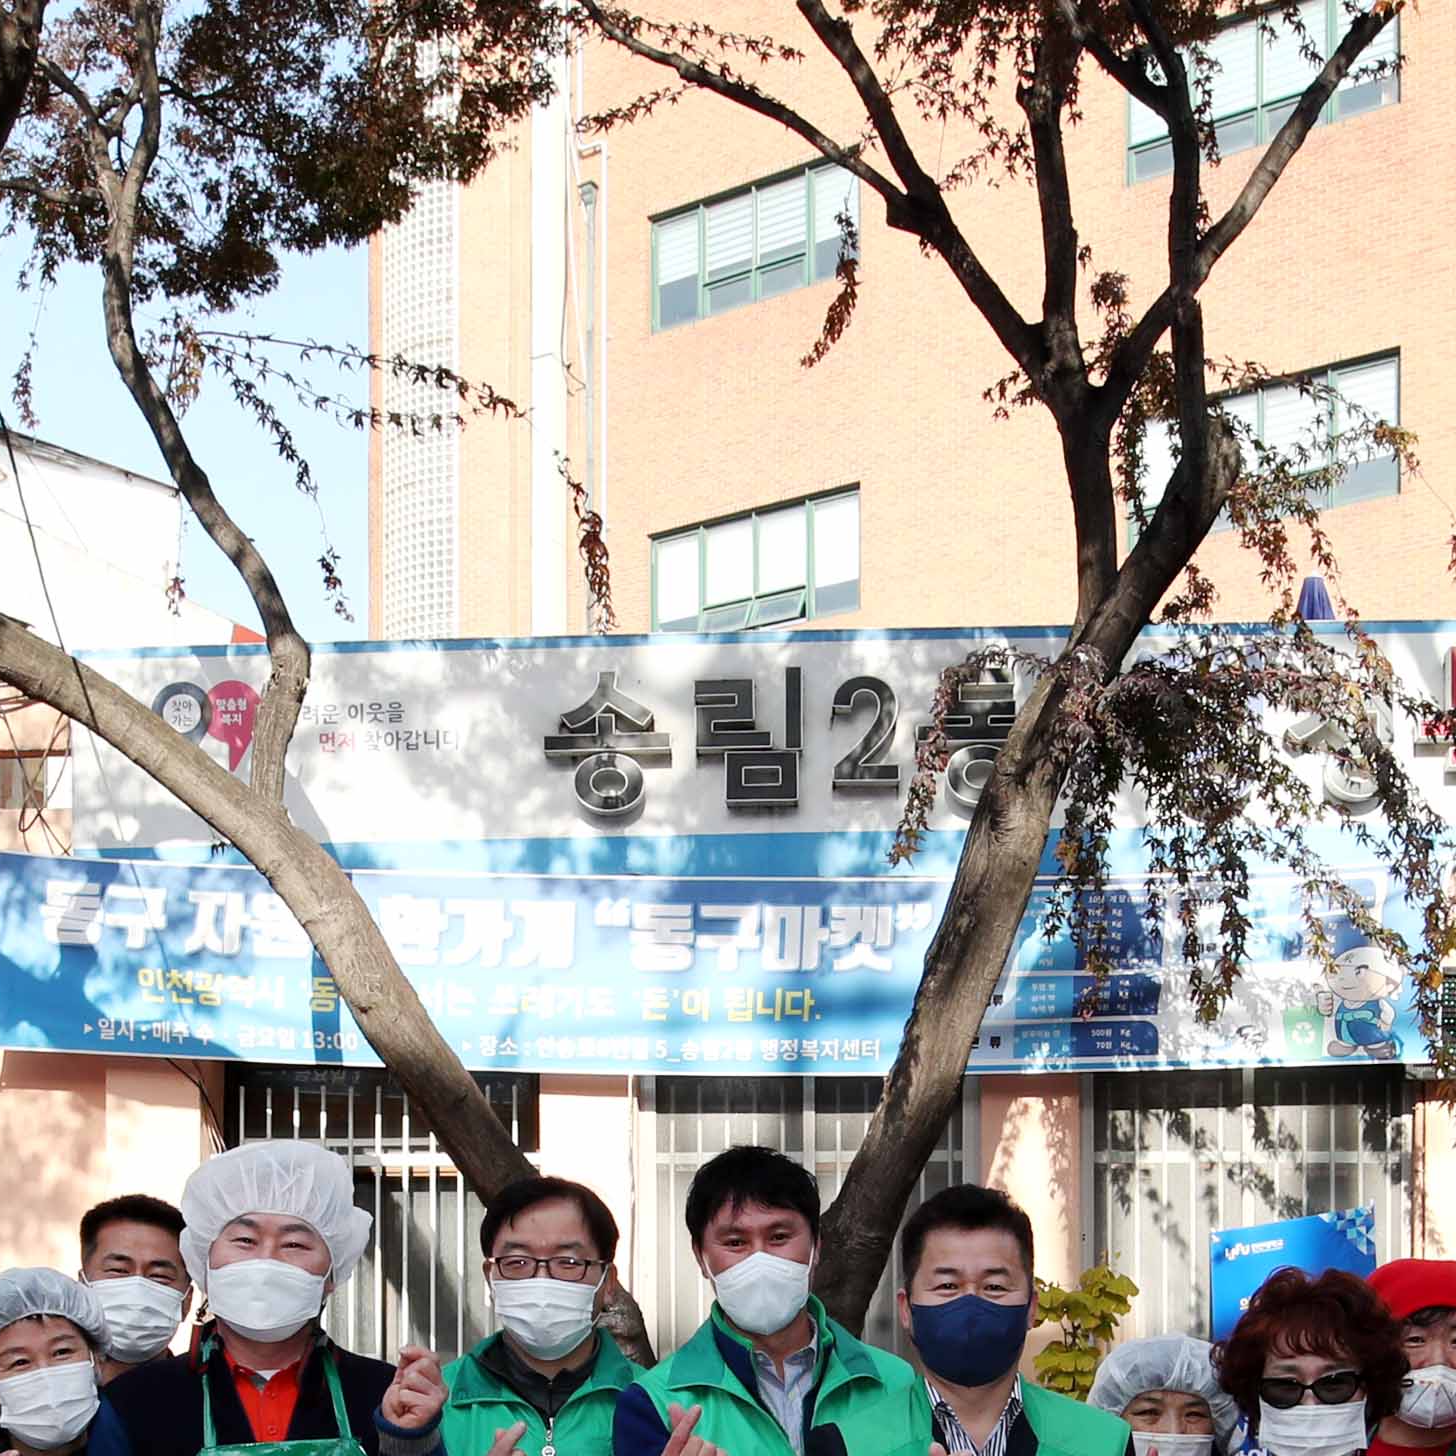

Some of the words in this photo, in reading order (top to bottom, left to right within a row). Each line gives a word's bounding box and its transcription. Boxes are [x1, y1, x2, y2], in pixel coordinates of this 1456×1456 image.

[347, 702, 406, 724] 이웃을
[319, 731, 356, 753] 먼저
[40, 879, 168, 949] 동구
[725, 986, 822, 1022] 됩니다.
[97, 1018, 136, 1041] 일시
[152, 1019, 189, 1045] 매주
[237, 1026, 297, 1050] 금요일
[303, 1030, 358, 1052] 13:00
[479, 1035, 519, 1058] 장소
[759, 1038, 881, 1062] 행정복지센터
